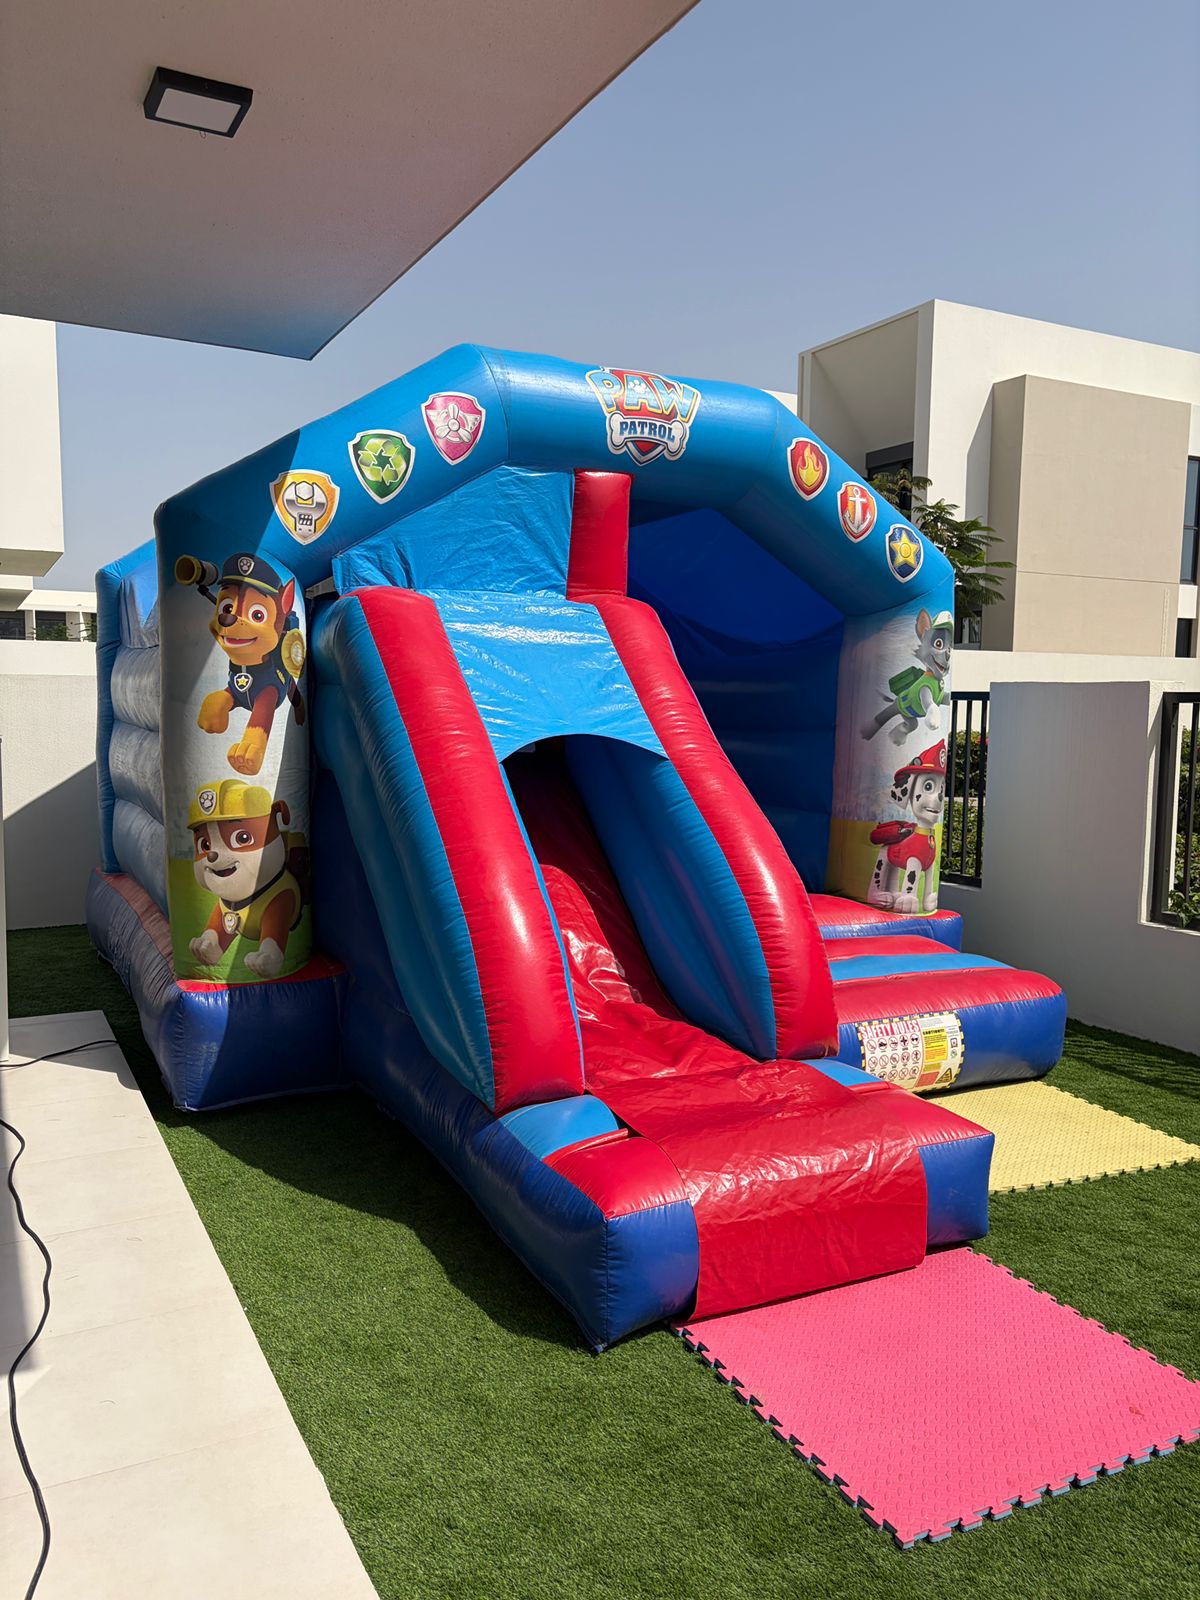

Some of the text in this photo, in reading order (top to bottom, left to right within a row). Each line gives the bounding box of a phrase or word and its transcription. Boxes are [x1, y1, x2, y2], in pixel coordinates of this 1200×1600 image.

[585, 370, 698, 423] PAW
[619, 420, 675, 443] PATROL
[860, 1023, 891, 1038] SAFETY
[893, 1020, 919, 1035] RULES
